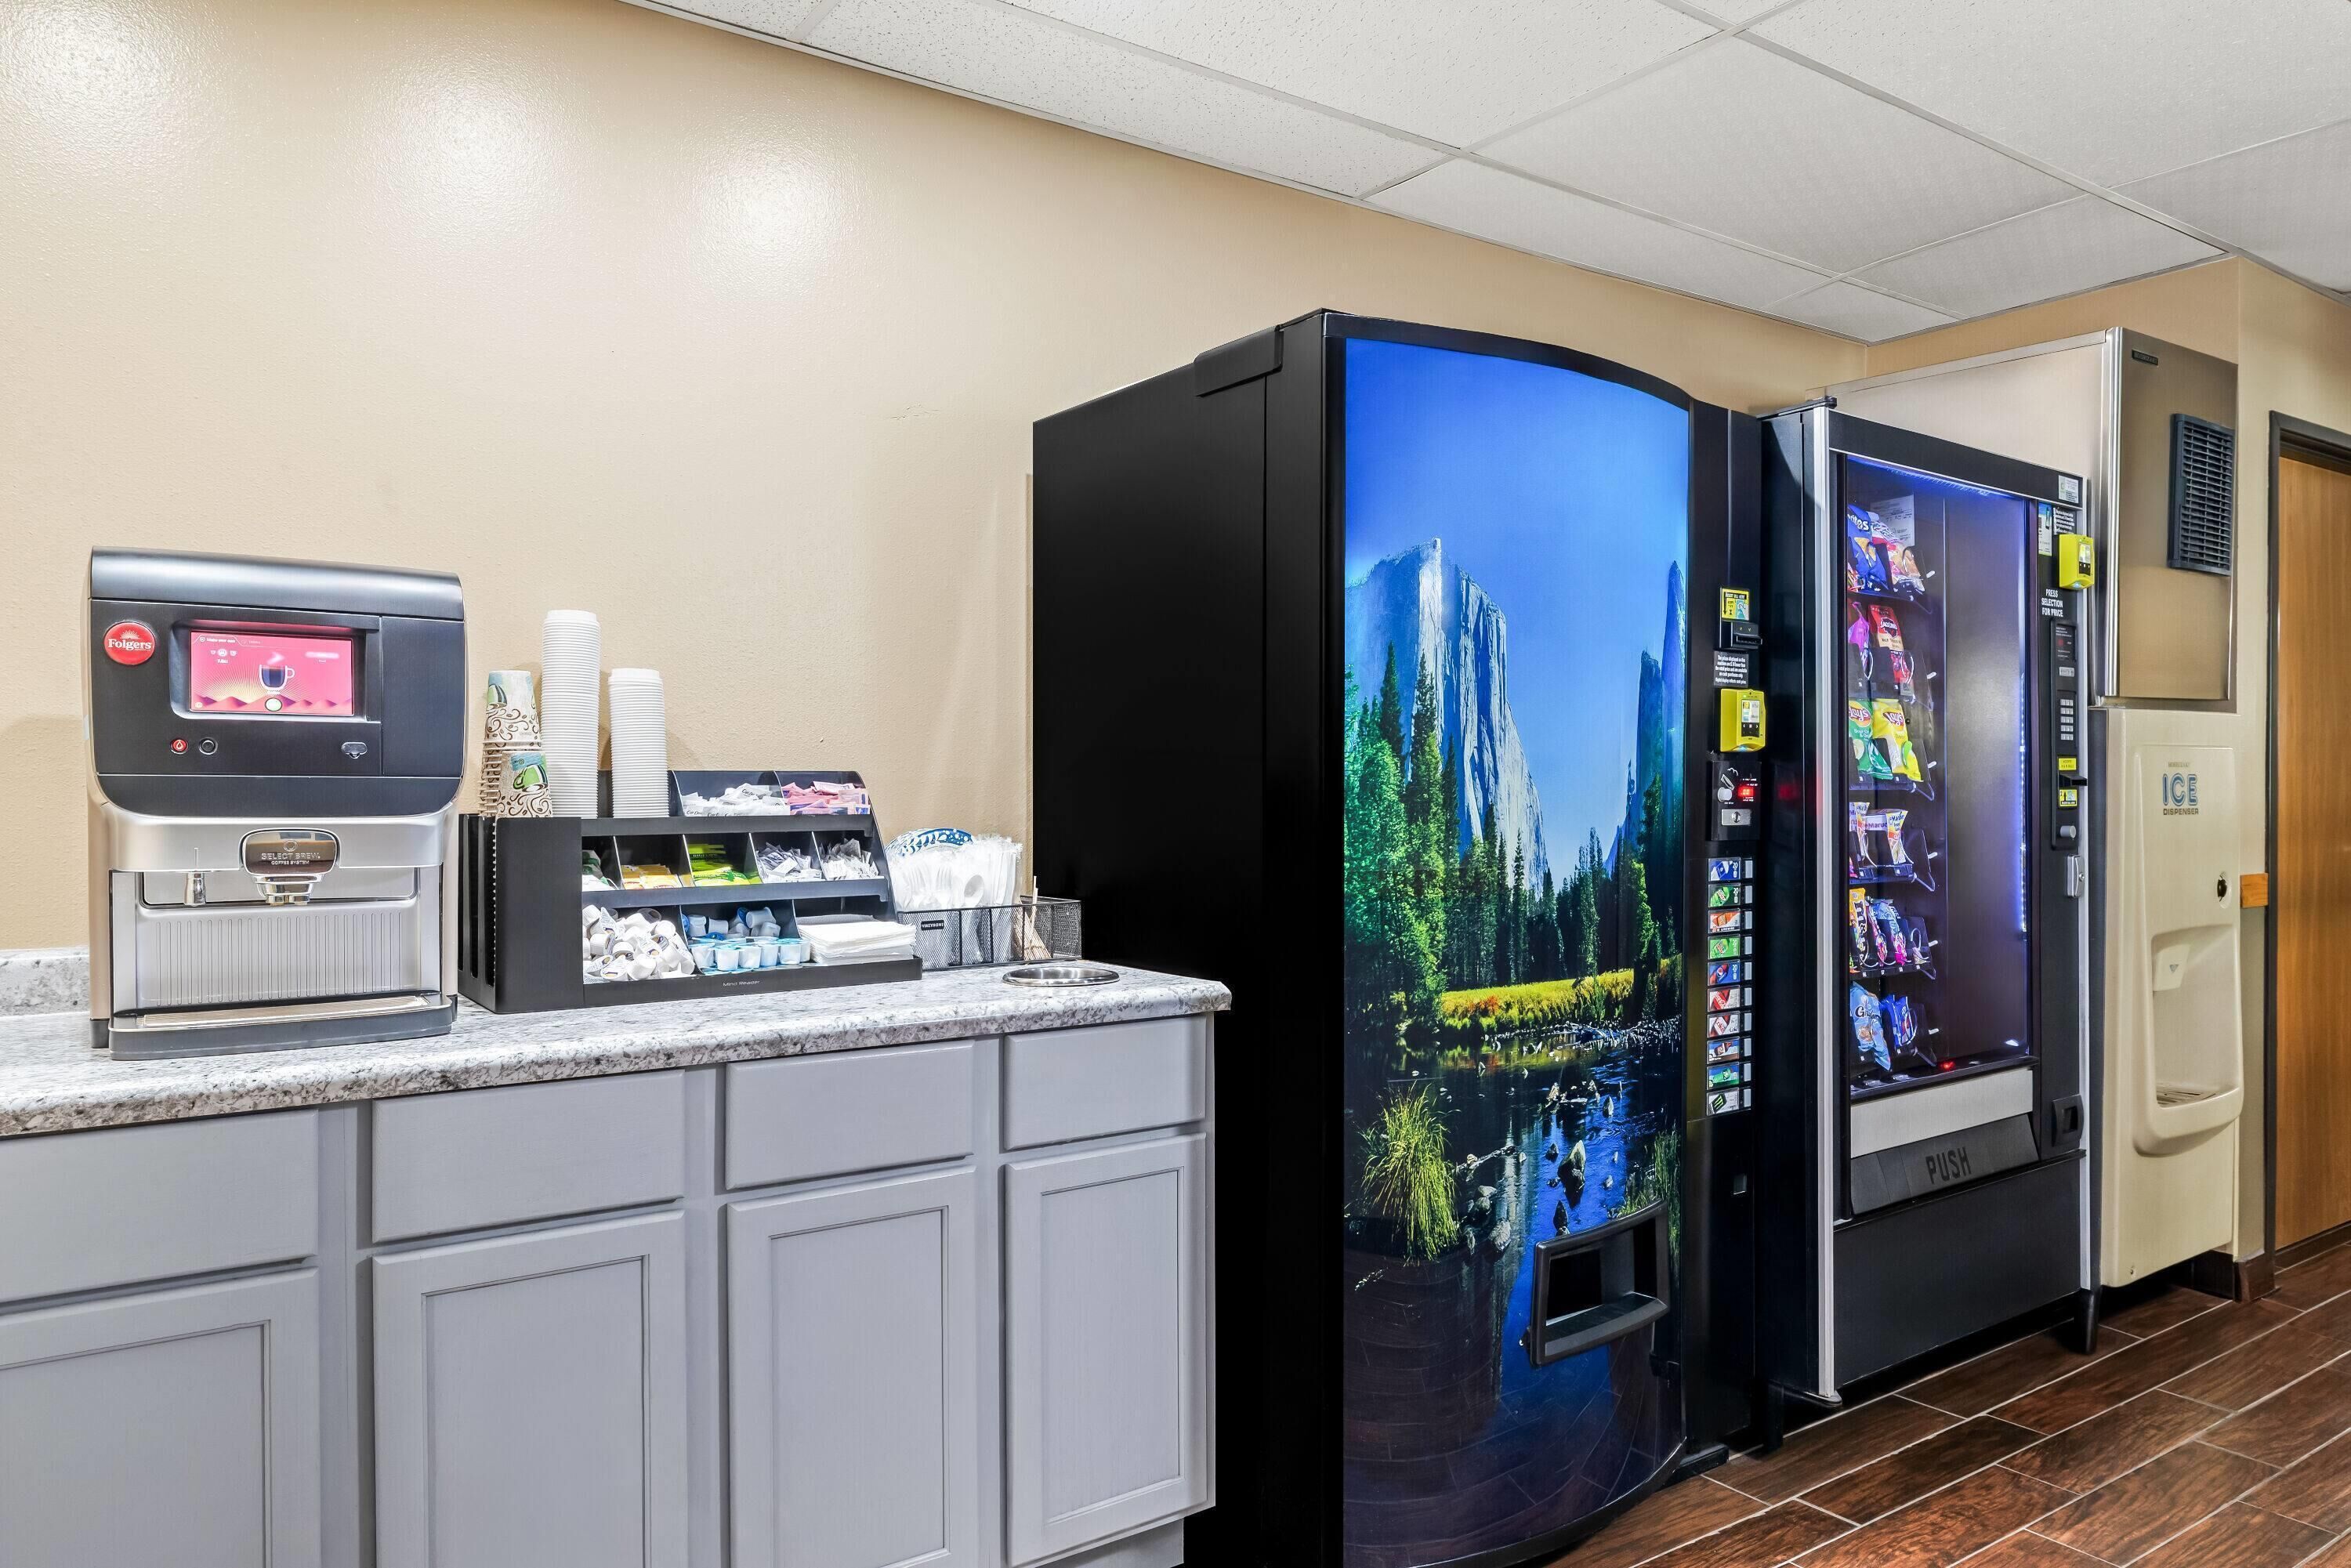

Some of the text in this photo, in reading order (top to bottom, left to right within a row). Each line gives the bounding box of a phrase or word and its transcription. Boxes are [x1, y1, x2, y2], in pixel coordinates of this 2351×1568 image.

[2045, 588, 2058, 598] PRESS
[2041, 597, 2063, 608] SELECTION
[2041, 607, 2063, 617] FOR PRICE
[107, 638, 152, 651] Folgers
[1885, 712, 1904, 726] Lay's
[2162, 773, 2197, 806] ICE
[1925, 1146, 1972, 1185] PUSH
